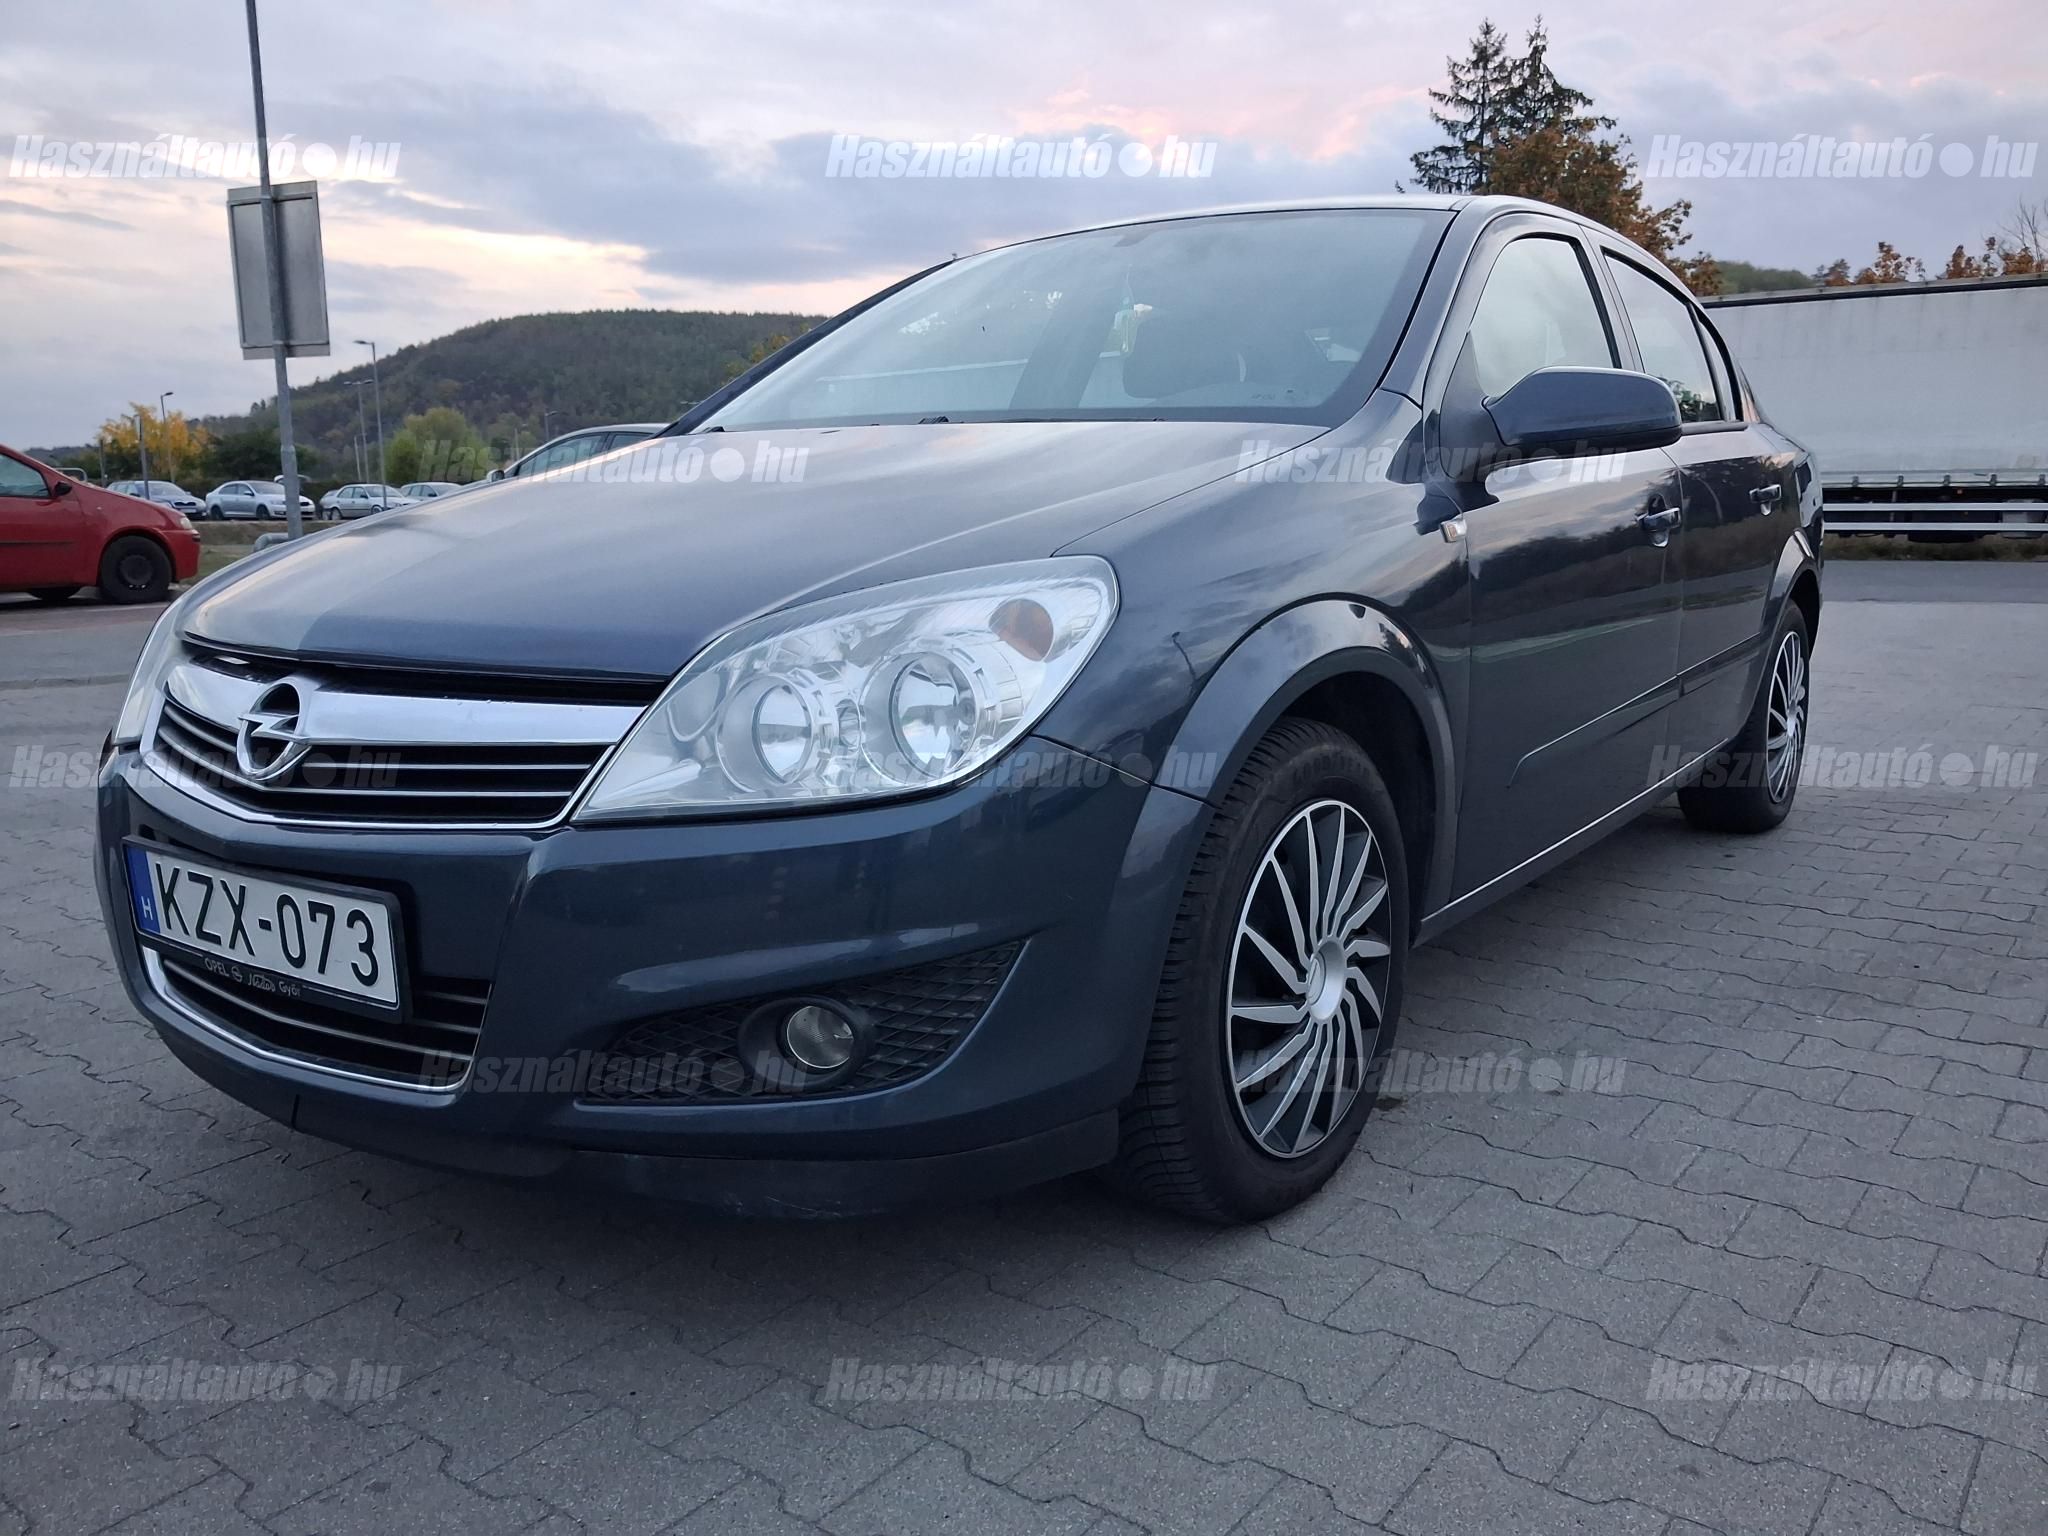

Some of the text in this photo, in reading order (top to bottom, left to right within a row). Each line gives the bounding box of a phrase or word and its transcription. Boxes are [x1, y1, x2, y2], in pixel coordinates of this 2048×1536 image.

[141, 896, 154, 920] H
[155, 863, 379, 987] KZX-073
[205, 958, 229, 977] OPEL
